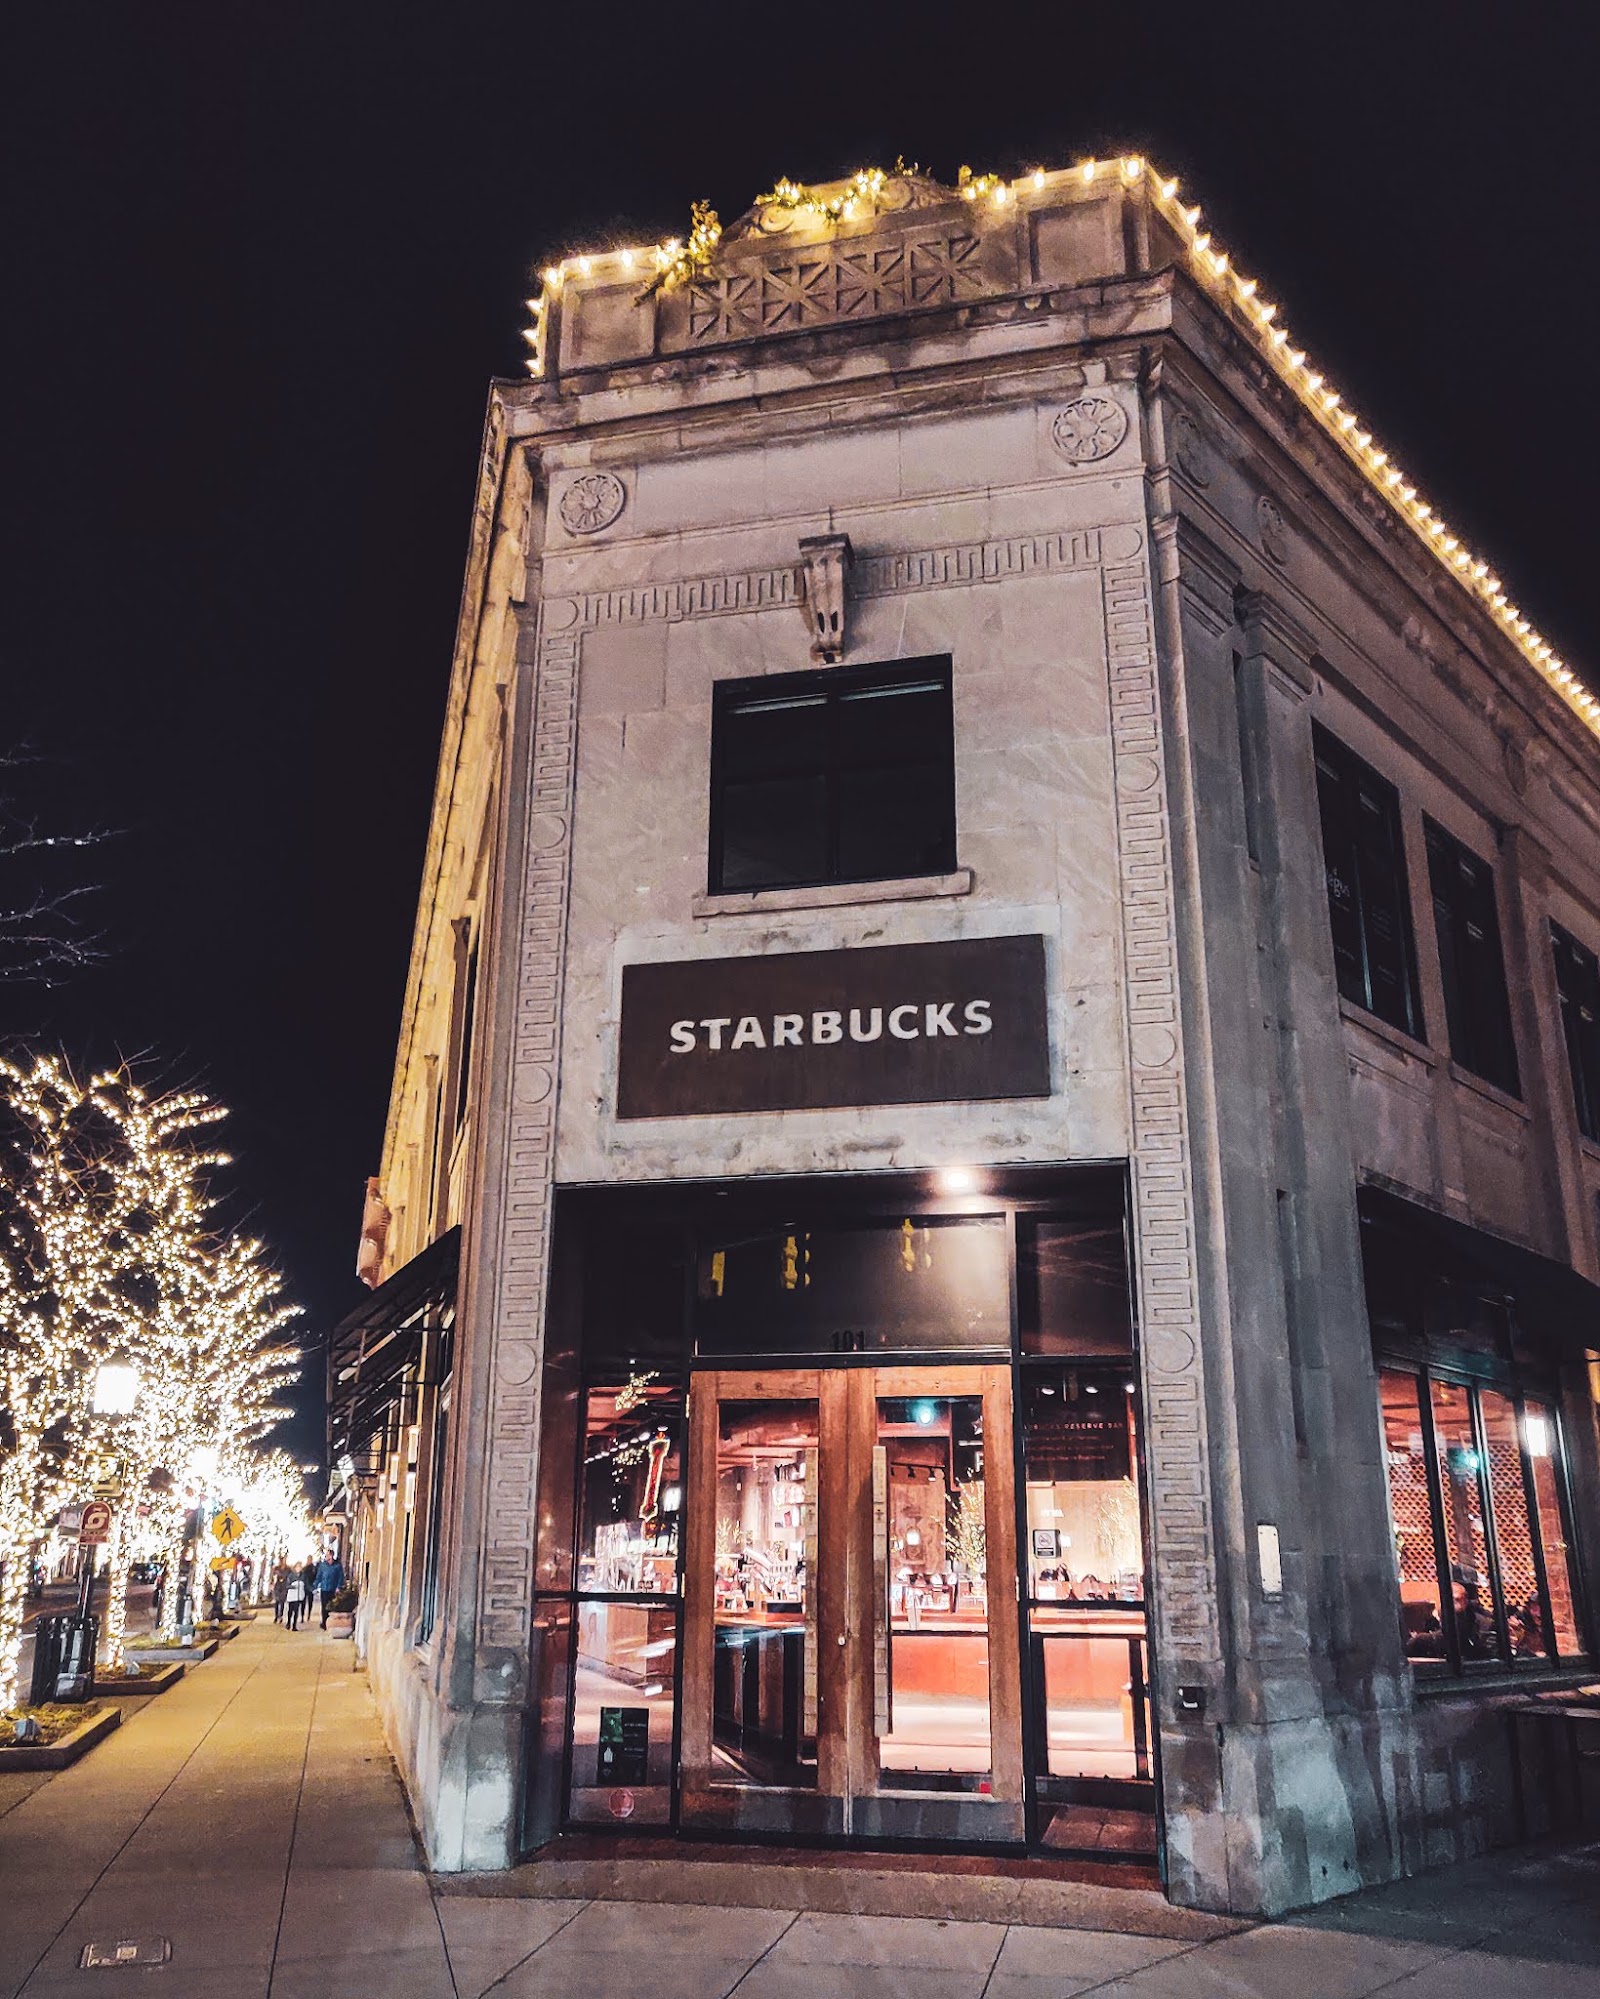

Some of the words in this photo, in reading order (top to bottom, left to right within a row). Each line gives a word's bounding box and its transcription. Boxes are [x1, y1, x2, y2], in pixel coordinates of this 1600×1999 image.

[669, 1000, 993, 1054] STARBUCKS
[831, 1329, 865, 1352] 101
[1064, 1422, 1104, 1430] RESERVE
